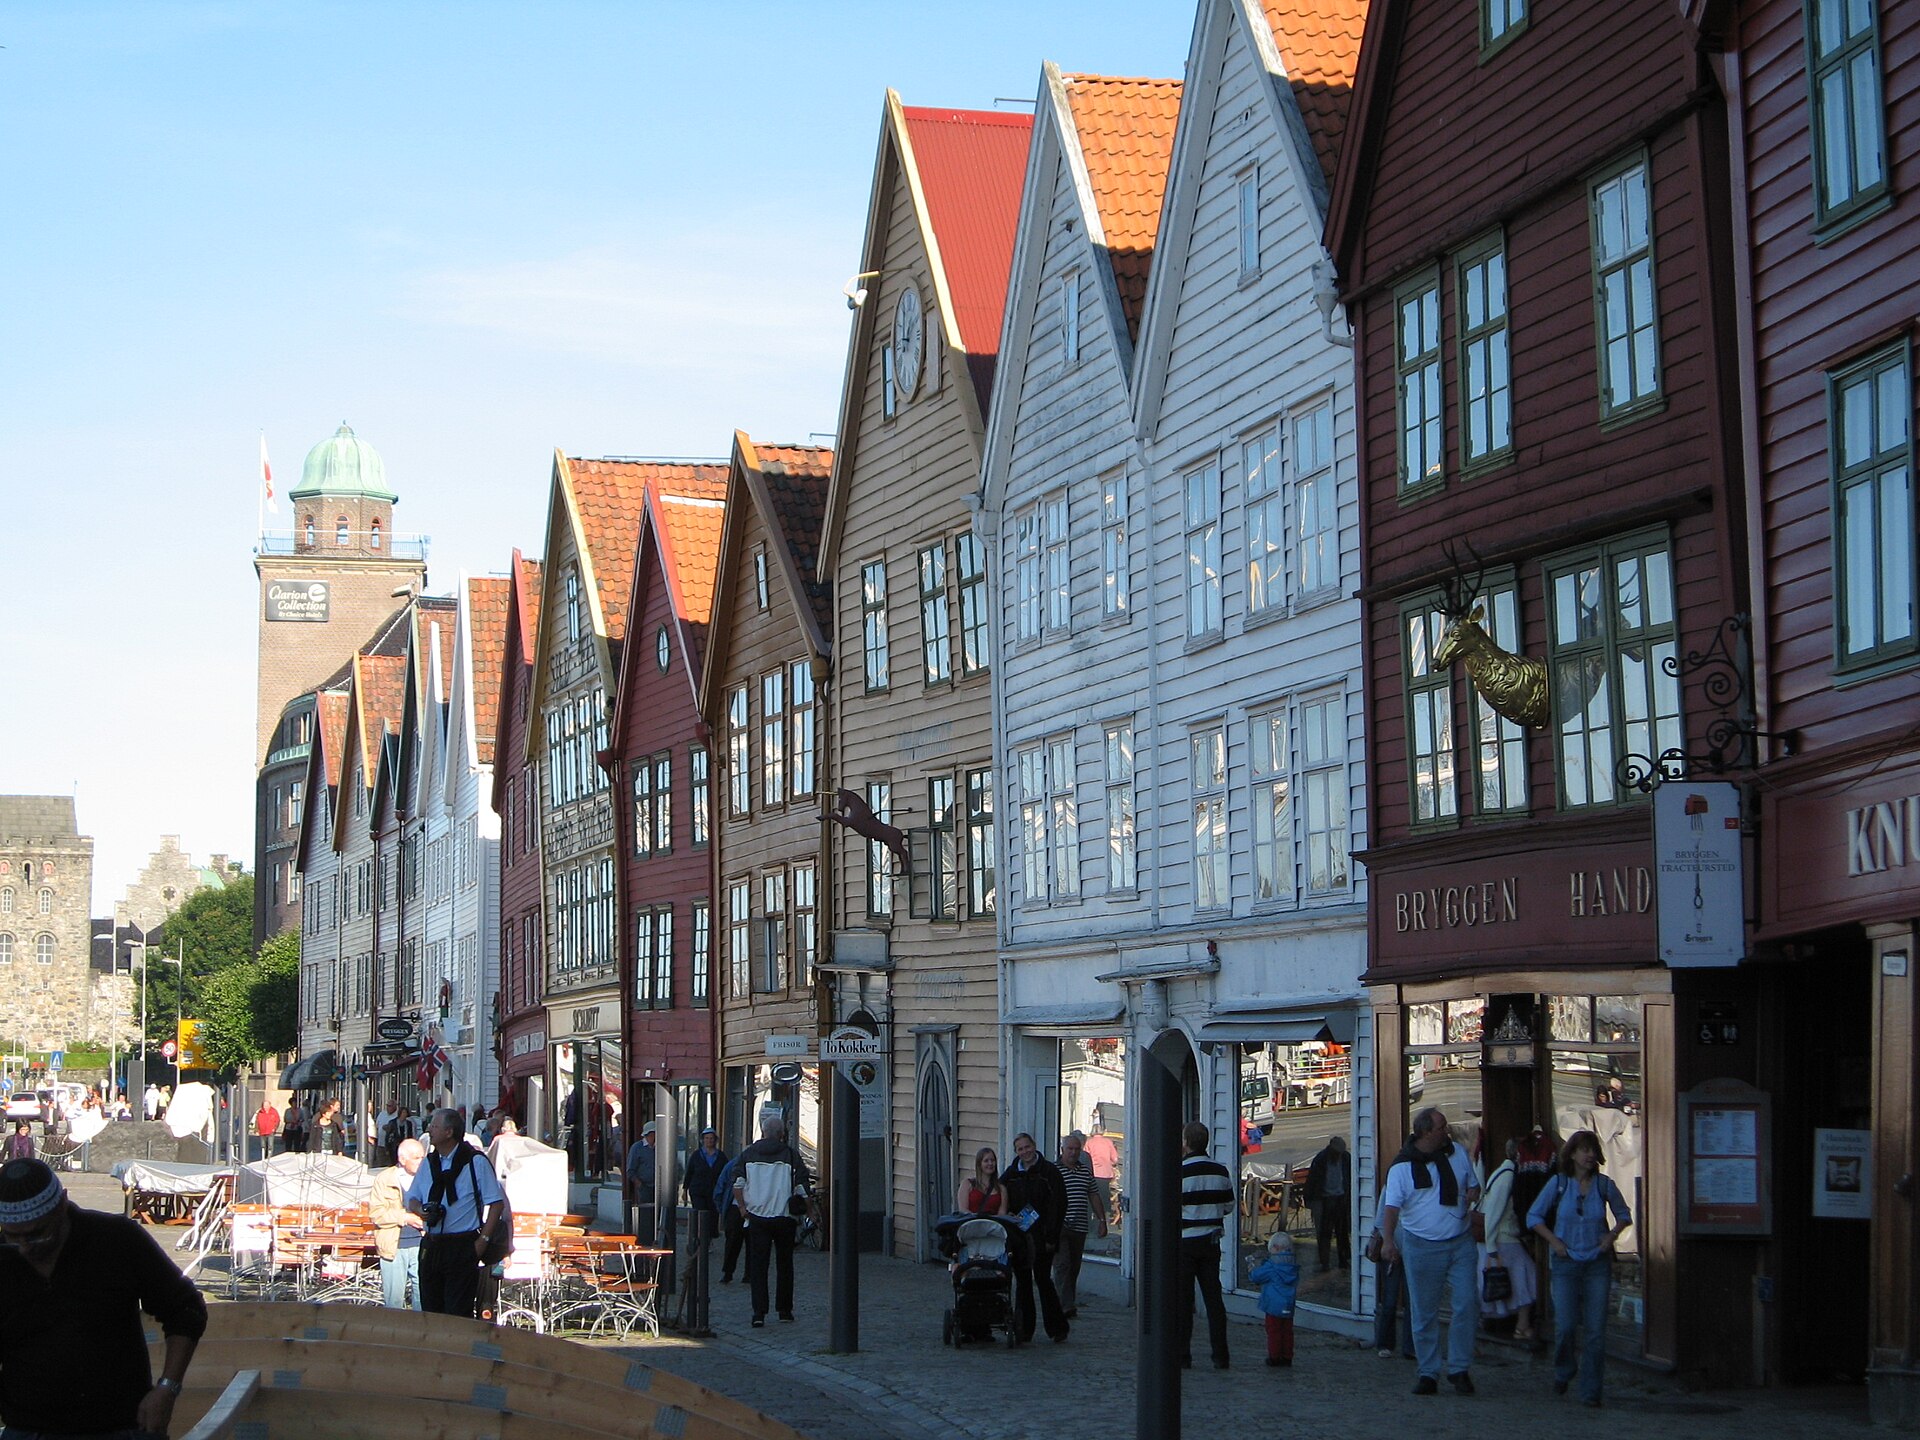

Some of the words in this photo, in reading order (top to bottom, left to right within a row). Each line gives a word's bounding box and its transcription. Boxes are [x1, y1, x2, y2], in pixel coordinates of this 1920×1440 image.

[269, 585, 307, 600] Clarion
[278, 600, 326, 611] Collection
[1675, 851, 1719, 859] BRYGGEN
[1660, 863, 1736, 872] TRACTEURSTED
[1396, 877, 1519, 933] BRYGGEN
[1570, 866, 1651, 917] HAND
[165, 1044, 174, 1052] 50
[824, 1040, 837, 1053] To
[839, 1040, 877, 1053] Kokker
